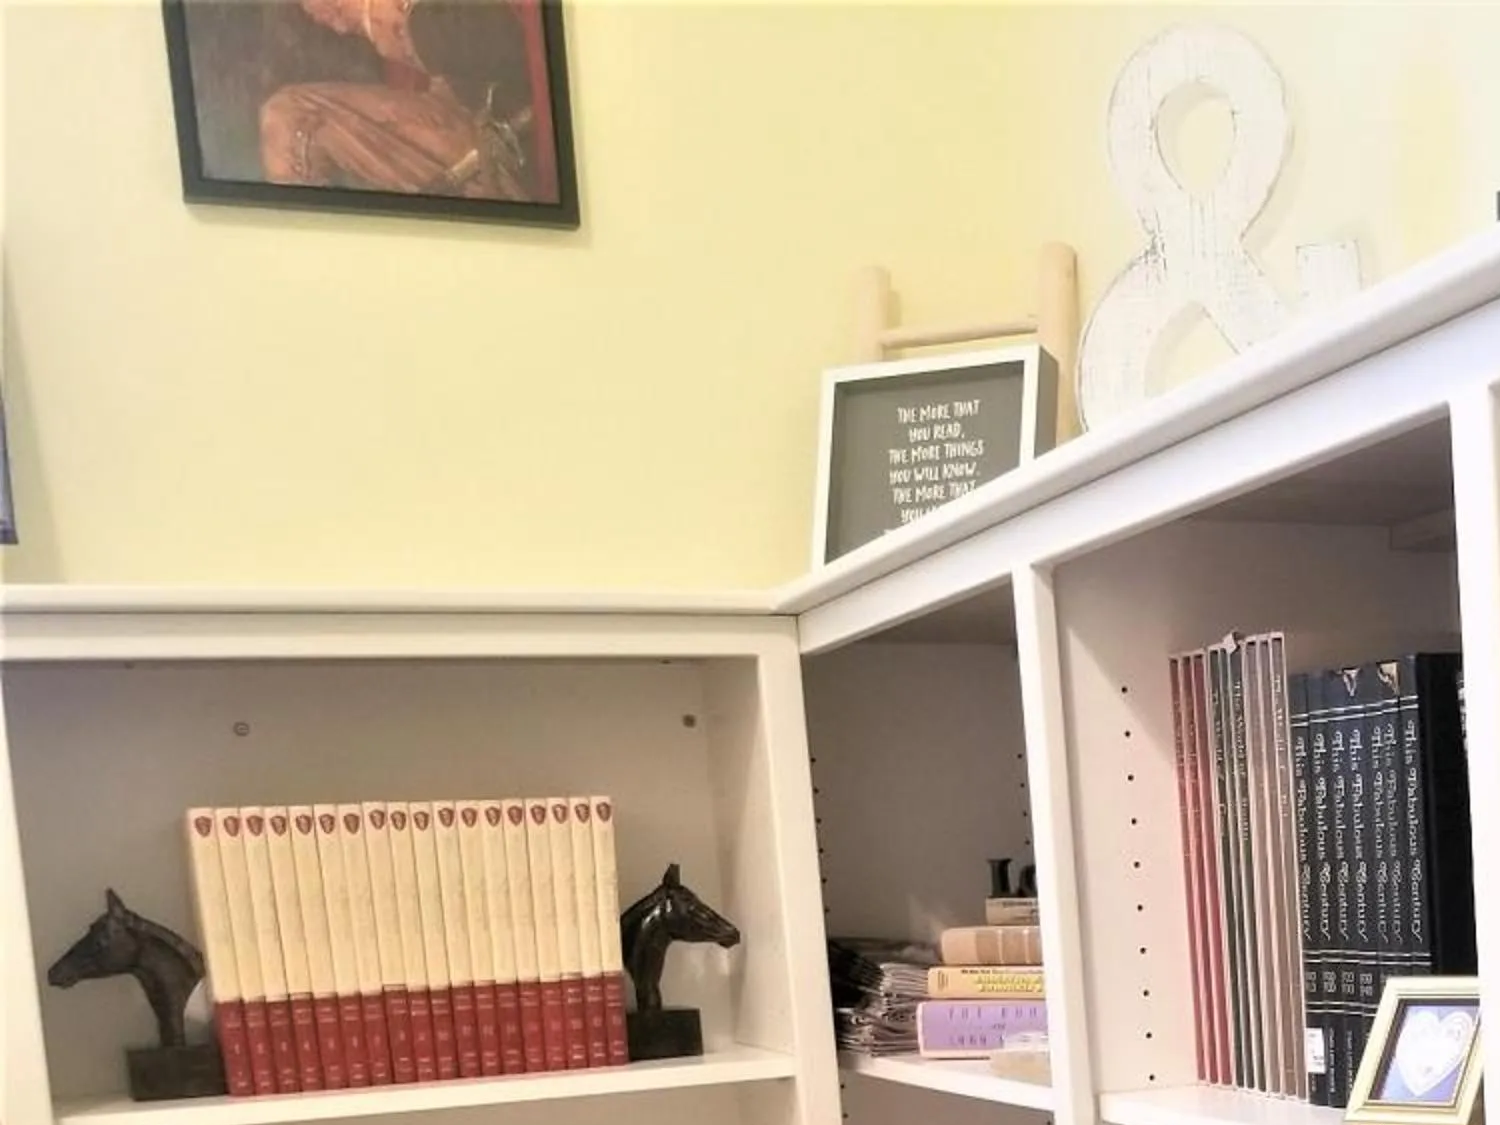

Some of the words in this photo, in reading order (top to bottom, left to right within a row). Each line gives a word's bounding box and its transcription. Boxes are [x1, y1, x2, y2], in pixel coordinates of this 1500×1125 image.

[898, 406, 917, 423] THE
[919, 403, 950, 420] MORE
[953, 400, 981, 417] THAT
[889, 449, 908, 464] THE
[911, 445, 940, 461] MORE
[944, 439, 985, 458] THINGS
[909, 427, 931, 443] YOU
[933, 423, 965, 439] READ,
[889, 469, 910, 484] YOU
[914, 466, 939, 481] WILL
[893, 488, 912, 503] THE
[915, 485, 946, 501] MORE
[949, 479, 977, 497] THAT
[1314, 733, 1324, 773] This
[1331, 731, 1343, 773] This
[1350, 729, 1361, 771] This
[1371, 726, 1382, 768] This
[1405, 720, 1417, 765] This
[1316, 777, 1328, 860] Fabulous
[1334, 776, 1346, 859] Fabulous
[1351, 774, 1363, 859] Fabulous
[1373, 773, 1384, 858] Fabulous
[1406, 768, 1419, 856] Fabulous
